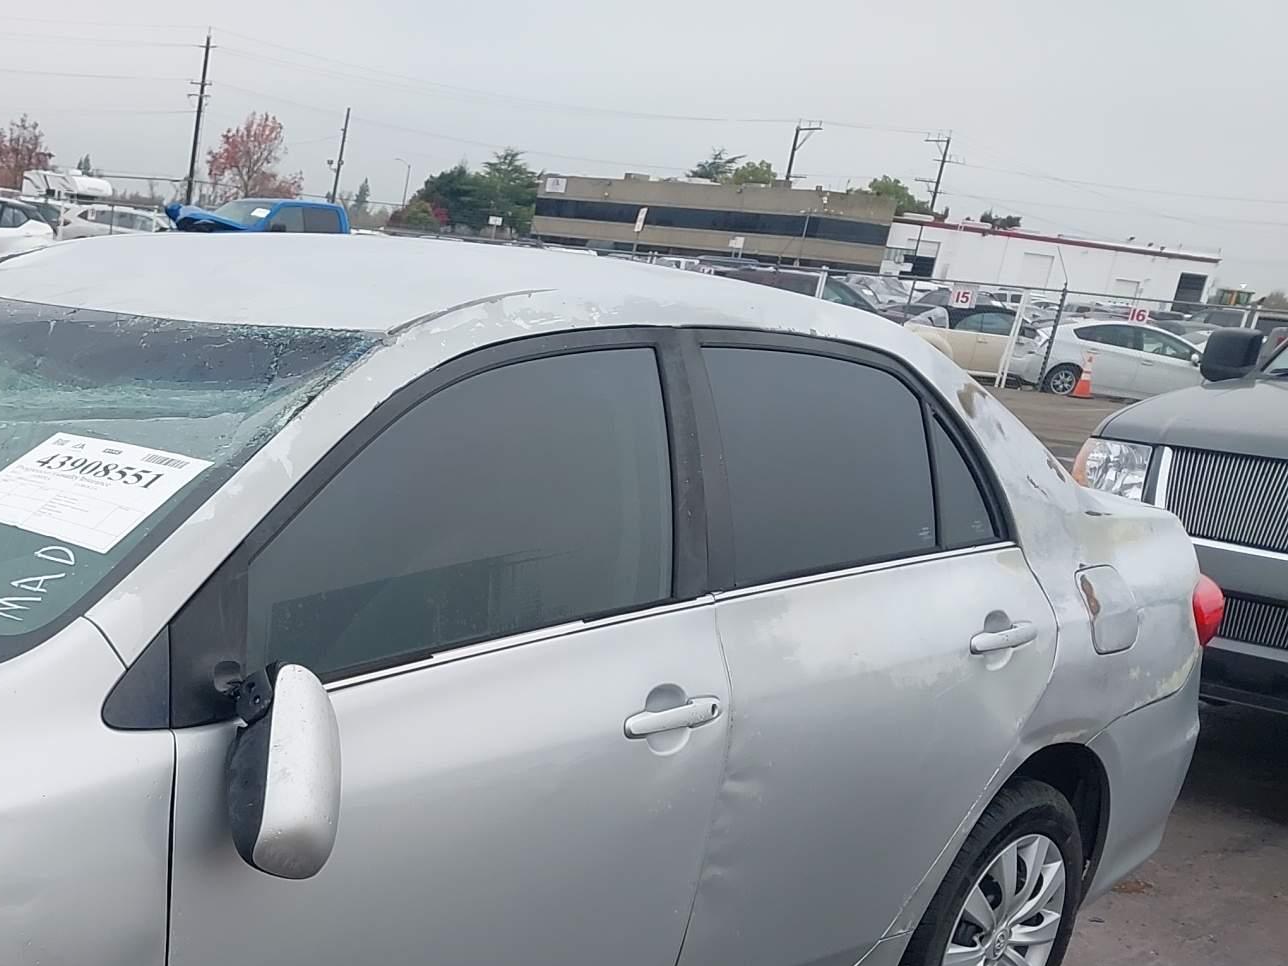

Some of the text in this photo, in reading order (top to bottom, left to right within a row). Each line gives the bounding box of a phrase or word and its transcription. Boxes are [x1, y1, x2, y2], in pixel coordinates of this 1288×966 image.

[955, 291, 970, 304] 15
[1130, 308, 1146, 322] 16
[35, 453, 165, 489] 43908551
